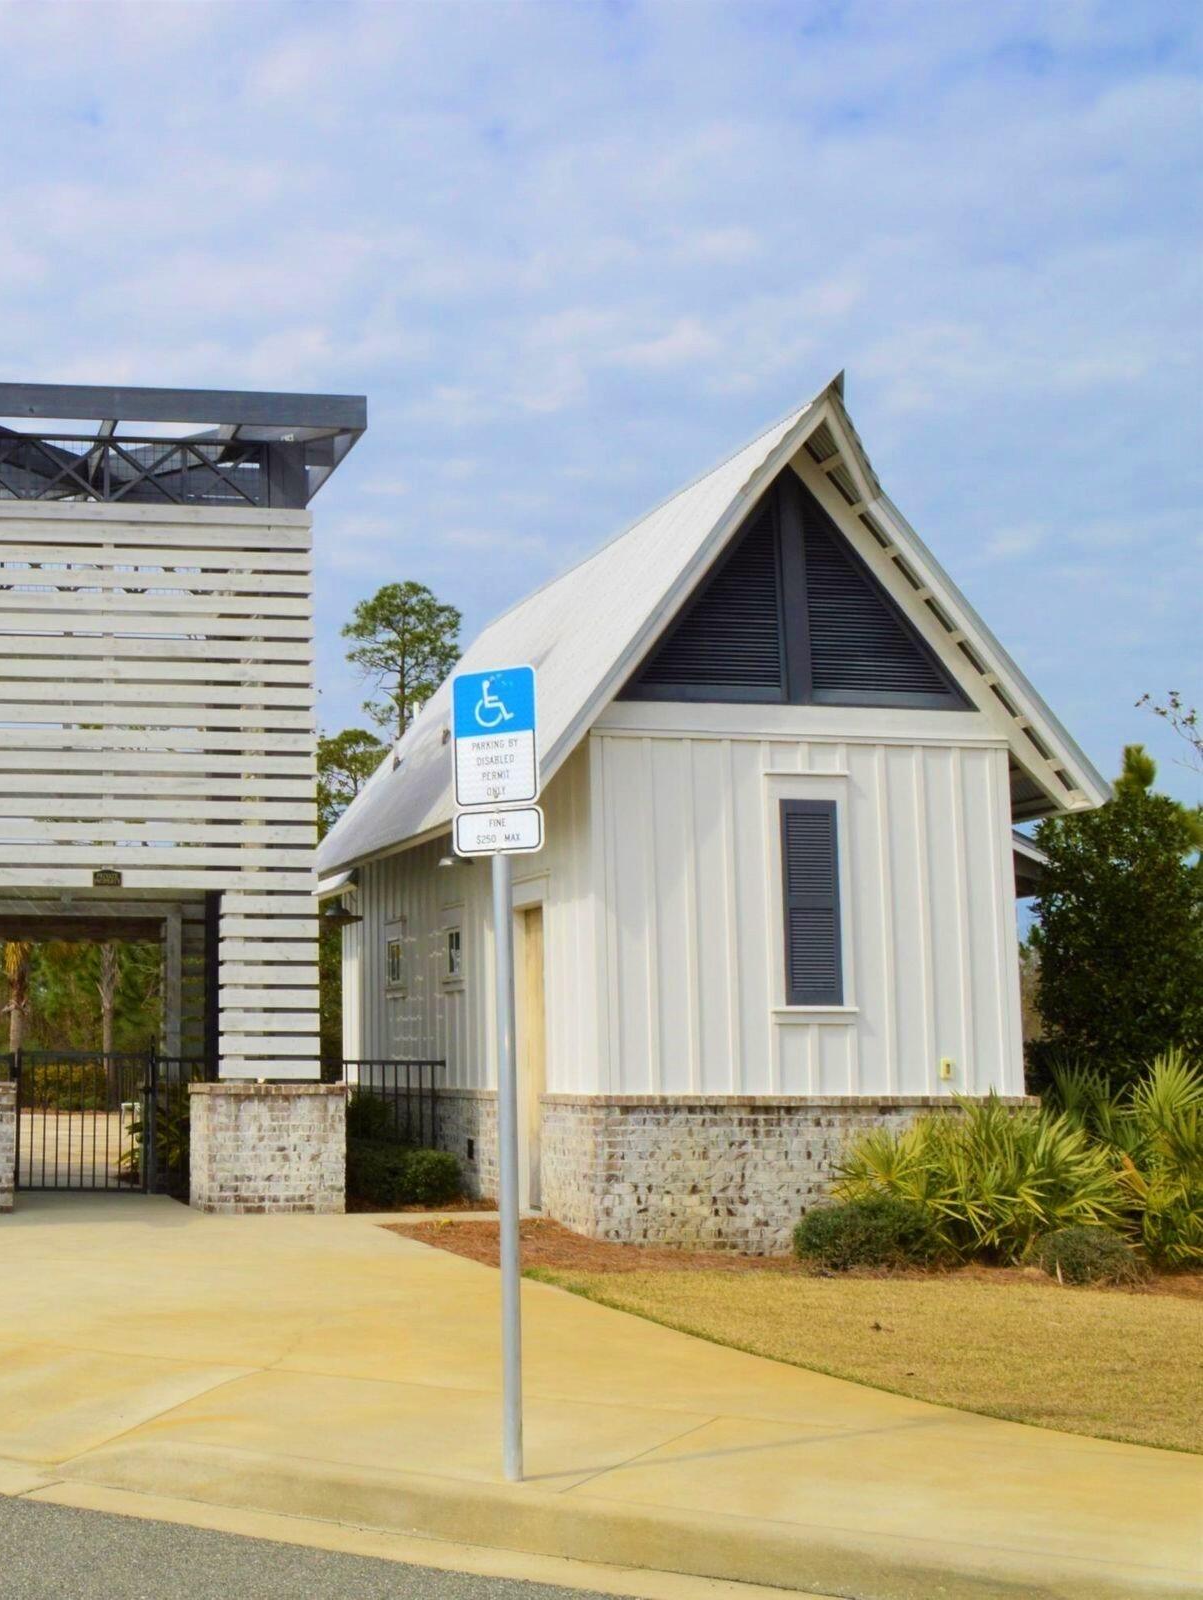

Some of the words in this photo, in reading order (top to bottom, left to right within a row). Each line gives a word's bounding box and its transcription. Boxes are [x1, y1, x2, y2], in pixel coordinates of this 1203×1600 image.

[472, 740, 504, 750] PARKING
[508, 739, 517, 747] BY
[476, 754, 514, 766] DISABLED
[482, 769, 509, 780] PERMIT
[486, 786, 505, 796] ONLY
[489, 818, 506, 827] FINE
[476, 834, 496, 844] $250
[504, 833, 520, 841] MAX
